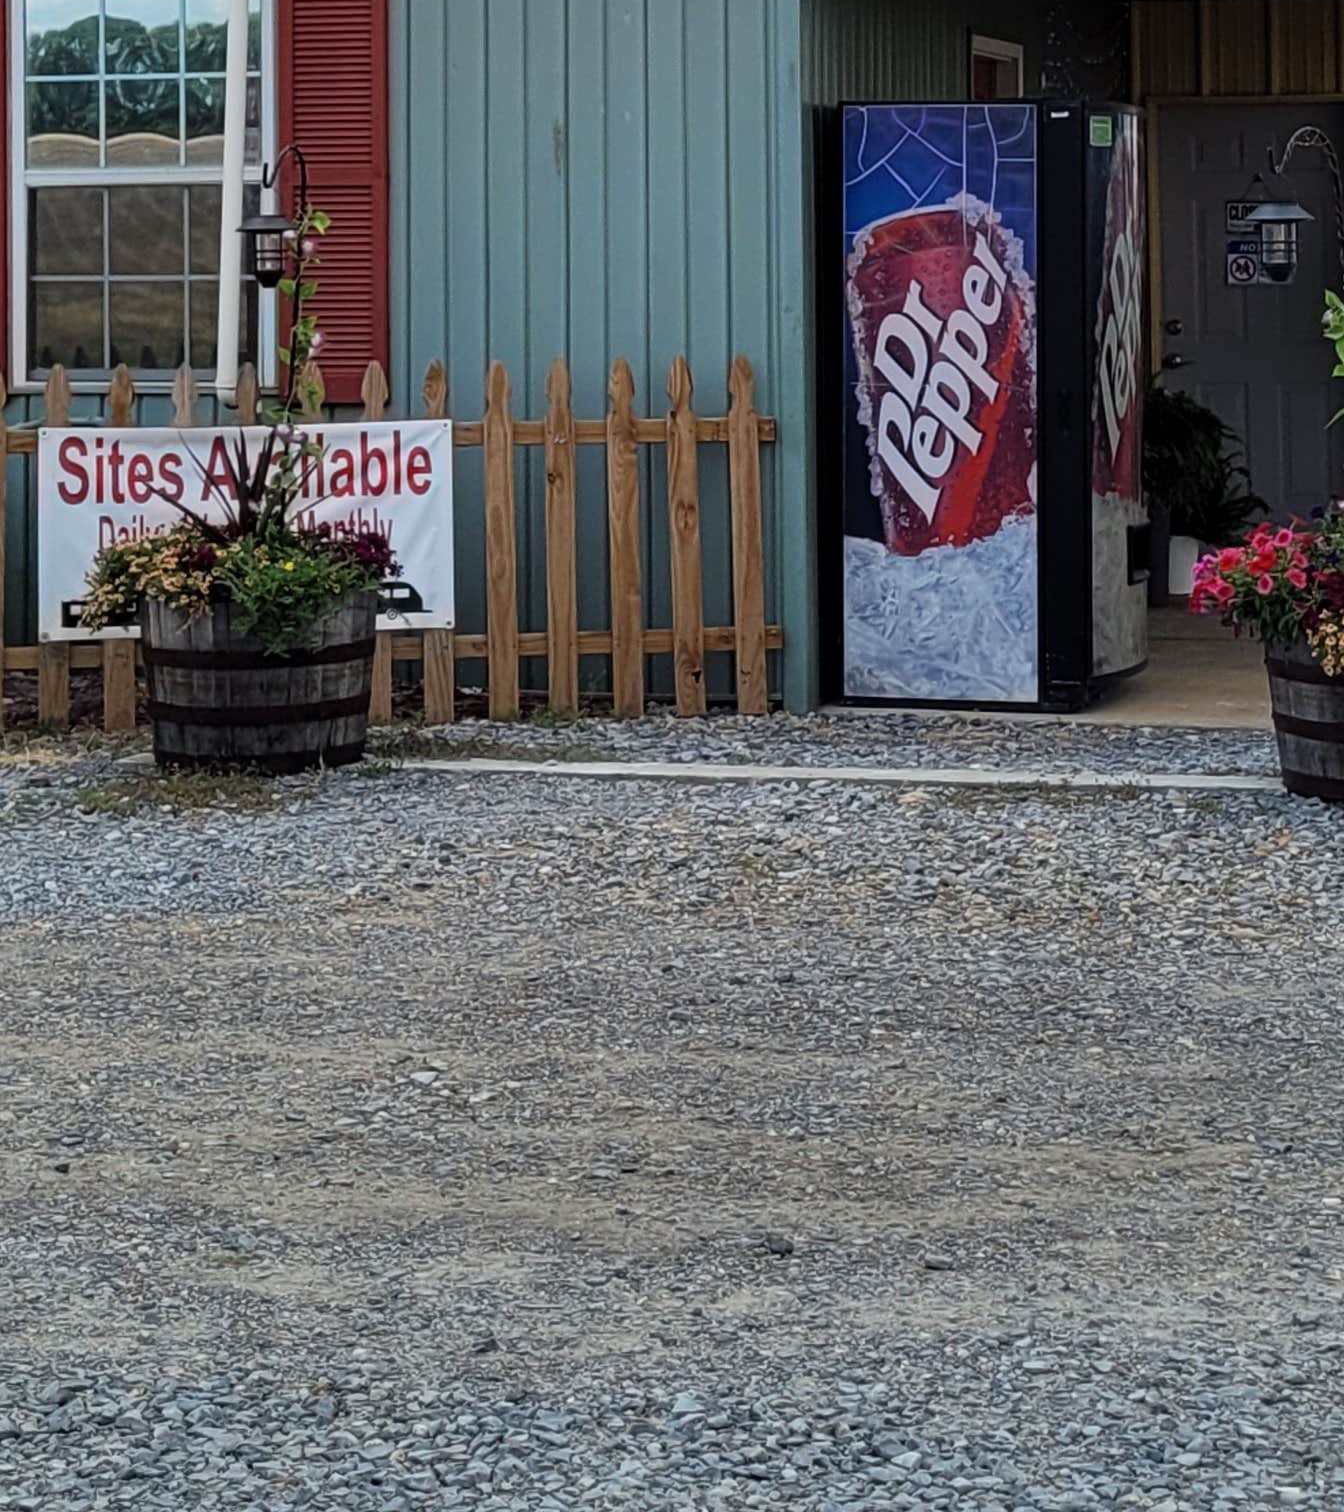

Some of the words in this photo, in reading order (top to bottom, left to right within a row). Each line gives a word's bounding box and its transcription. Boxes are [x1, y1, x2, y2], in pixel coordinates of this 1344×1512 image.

[873, 279, 945, 413] Dr
[877, 231, 1008, 525] Pepper
[57, 435, 185, 506] Sites
